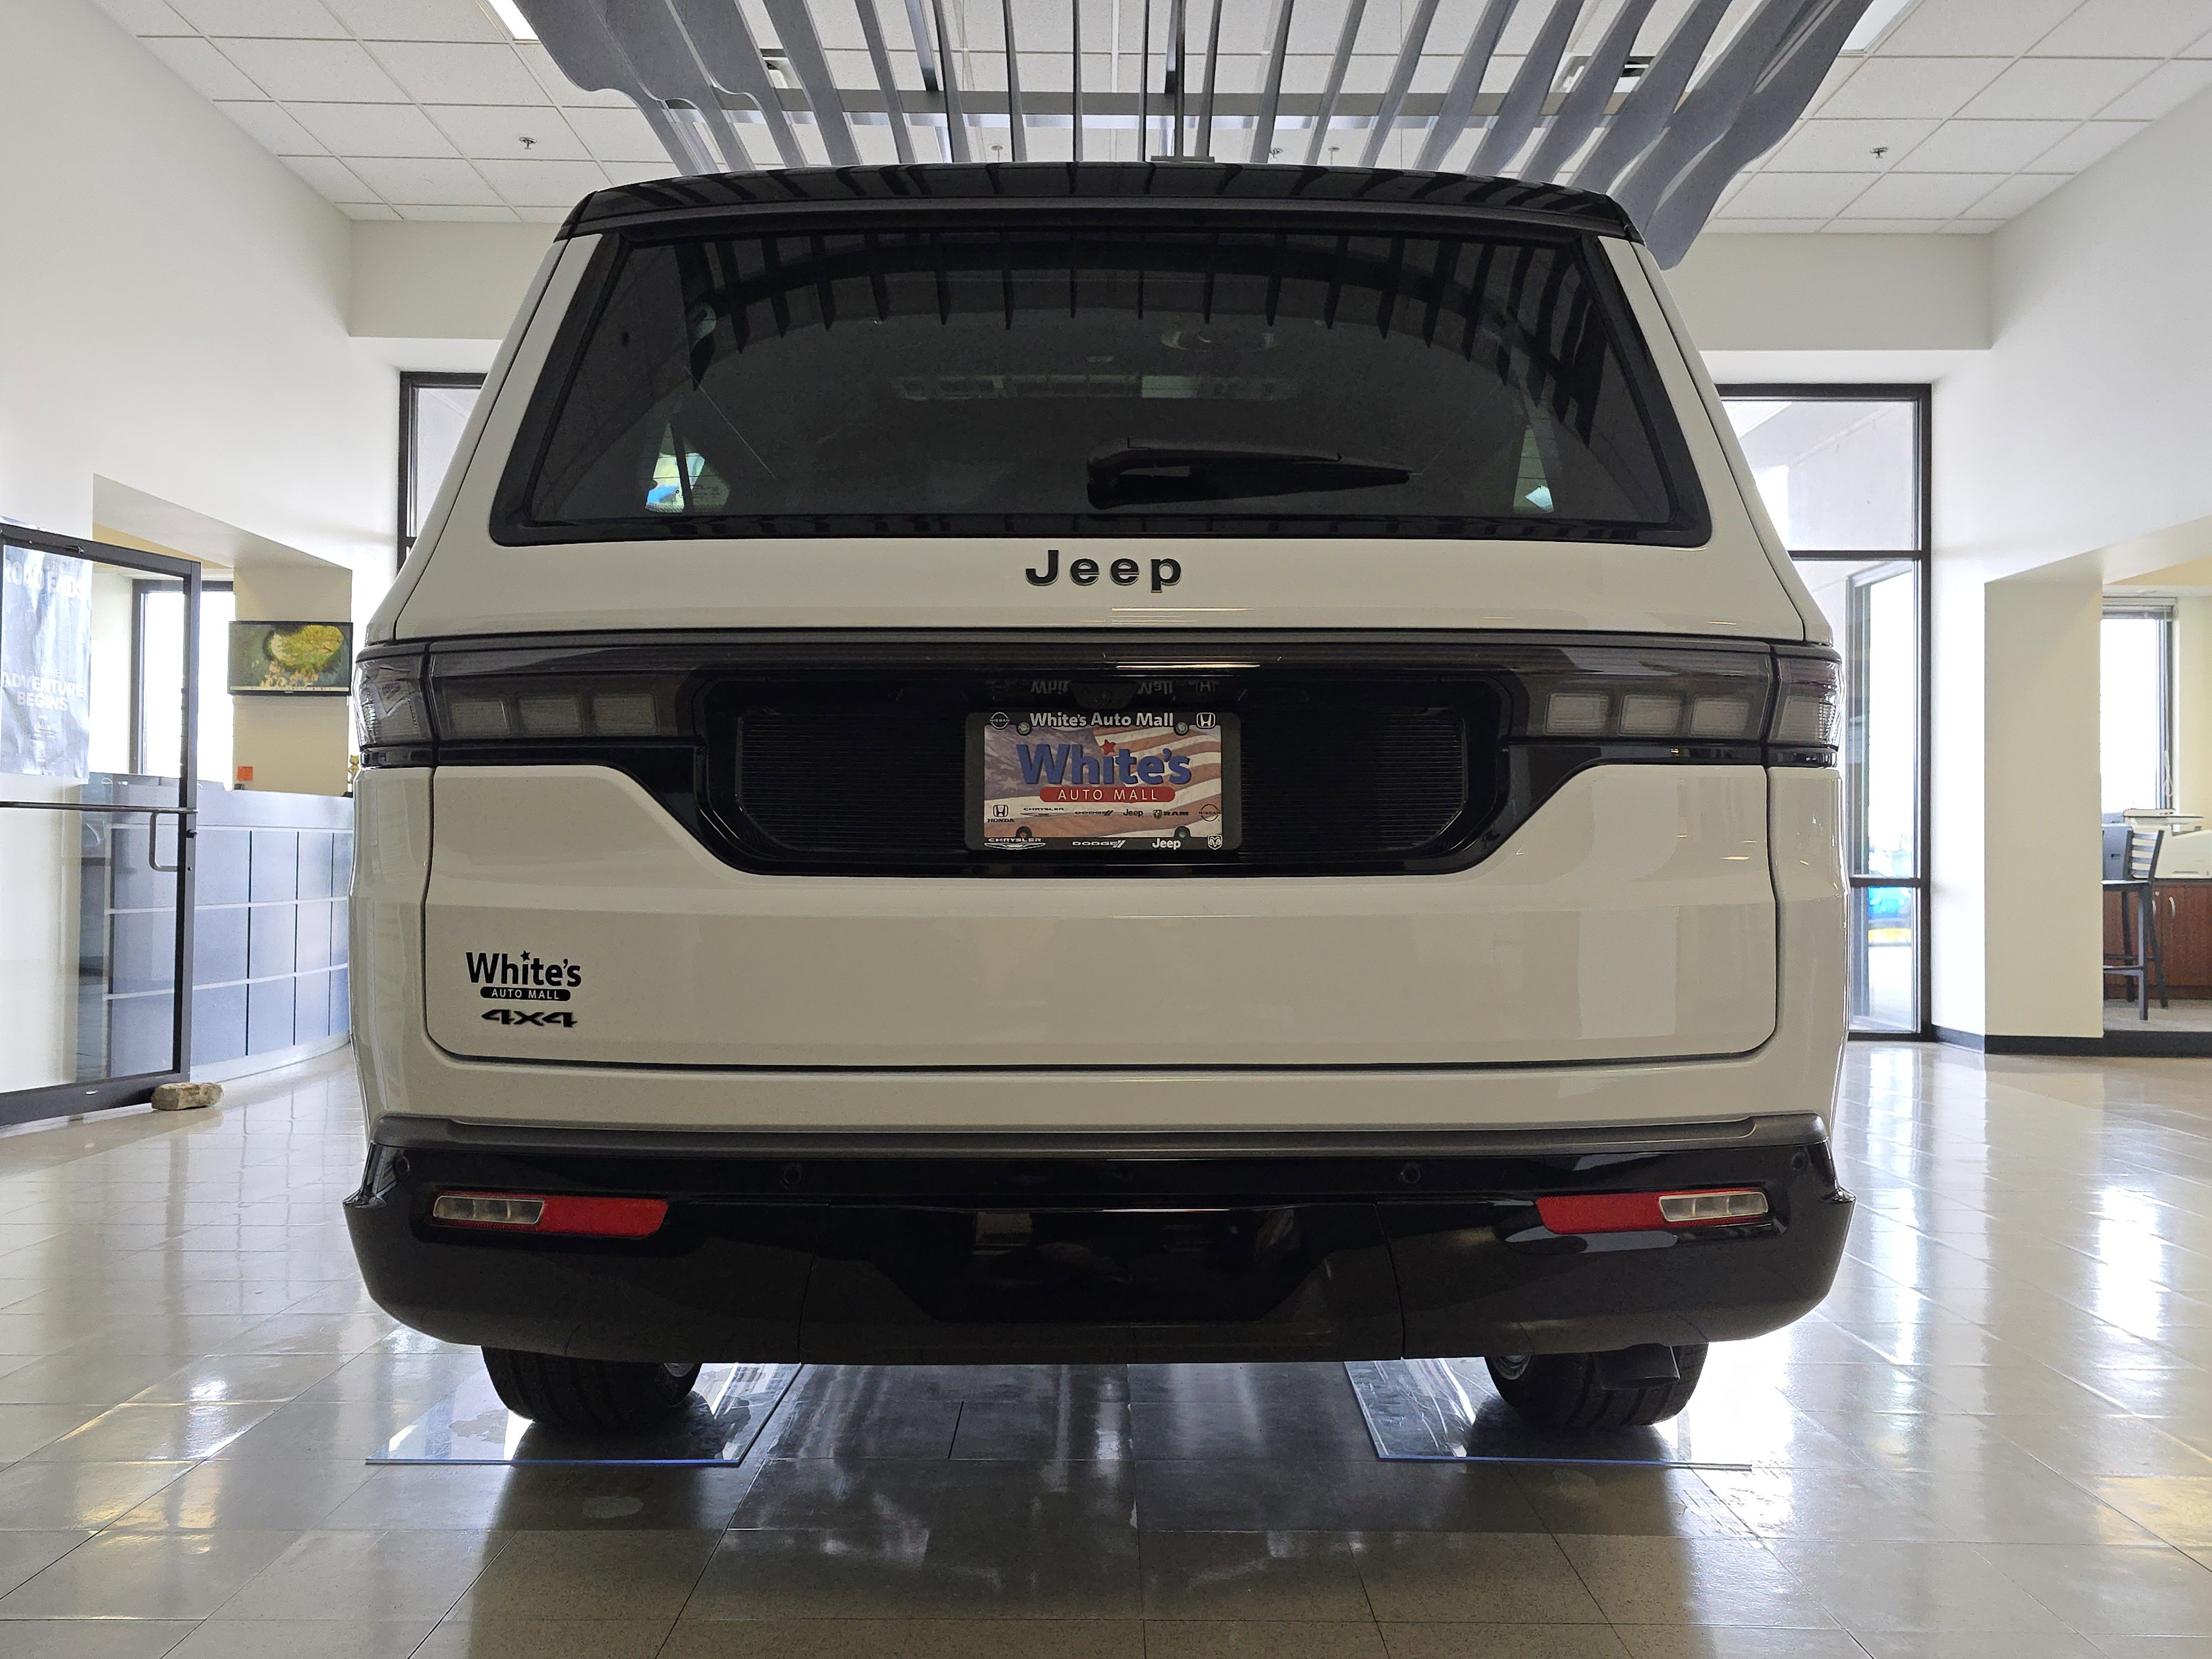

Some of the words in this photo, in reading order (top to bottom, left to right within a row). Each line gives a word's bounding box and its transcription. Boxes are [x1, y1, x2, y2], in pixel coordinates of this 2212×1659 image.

[1025, 550, 1181, 593] Jeep
[2, 672, 85, 697] ADVENTURE
[17, 691, 68, 711] BEGINS
[1030, 712, 1087, 727] White's
[1091, 712, 1131, 726] Auto
[1136, 712, 1173, 727] Mall
[1016, 739, 1192, 785] White's
[1058, 789, 1103, 801] AUTO
[1113, 789, 1157, 801] MALL
[1152, 838, 1181, 850] Jeep
[466, 950, 581, 987] White's
[491, 989, 522, 998] AUTO
[528, 990, 560, 999] MALL
